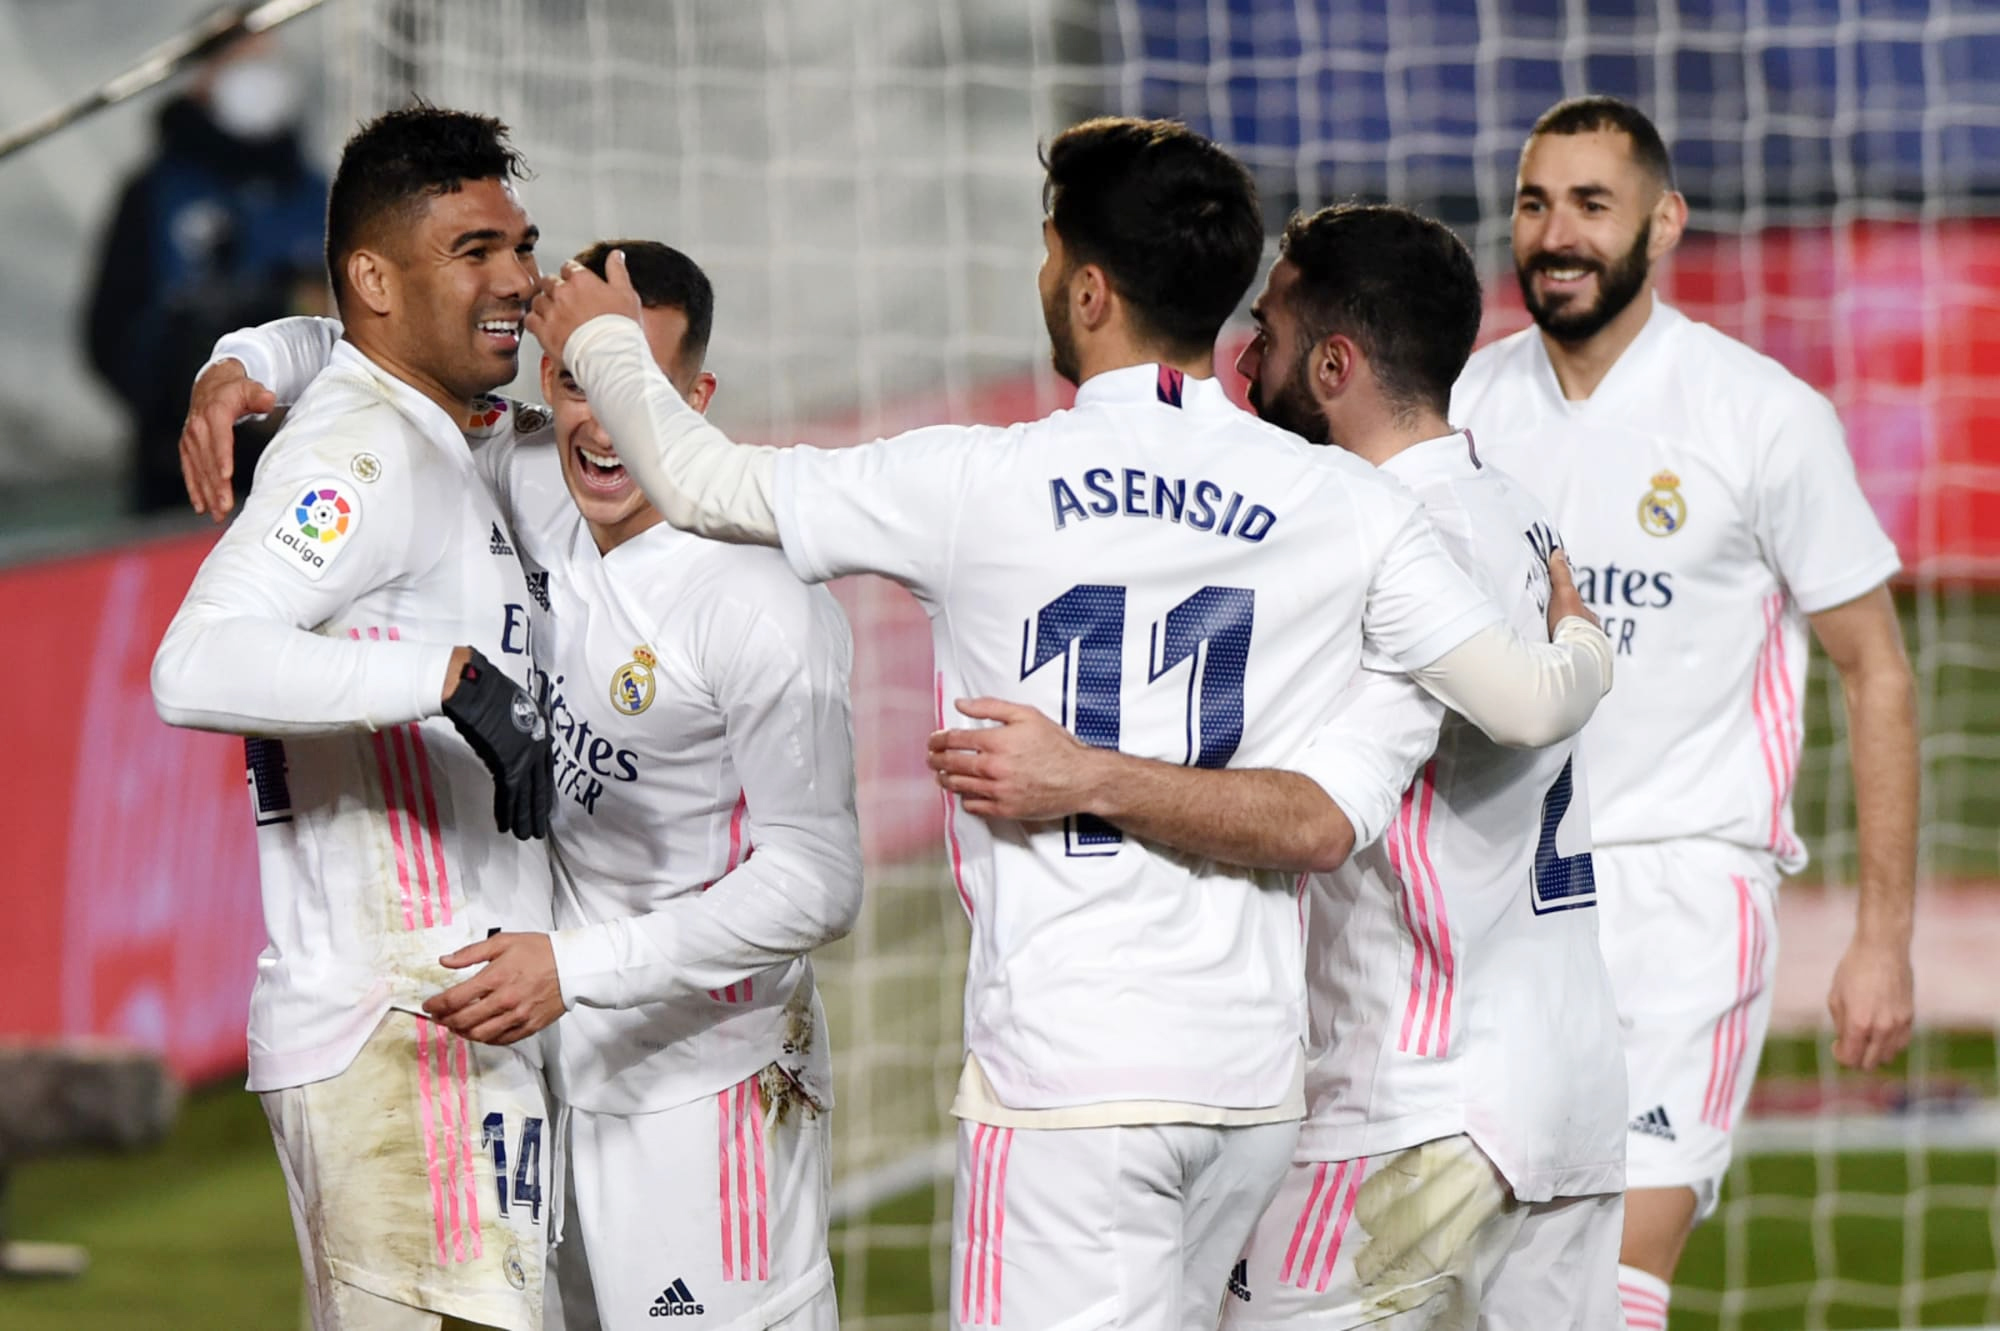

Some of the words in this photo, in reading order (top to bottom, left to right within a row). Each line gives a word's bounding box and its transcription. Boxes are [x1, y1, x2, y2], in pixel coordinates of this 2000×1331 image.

[1049, 468, 1277, 543] ASENSIO
[275, 527, 325, 568] LaLiga
[1574, 561, 1674, 609] ates
[1020, 584, 1255, 858] 11
[482, 1112, 544, 1225] 14
[648, 1301, 705, 1317] adidas
